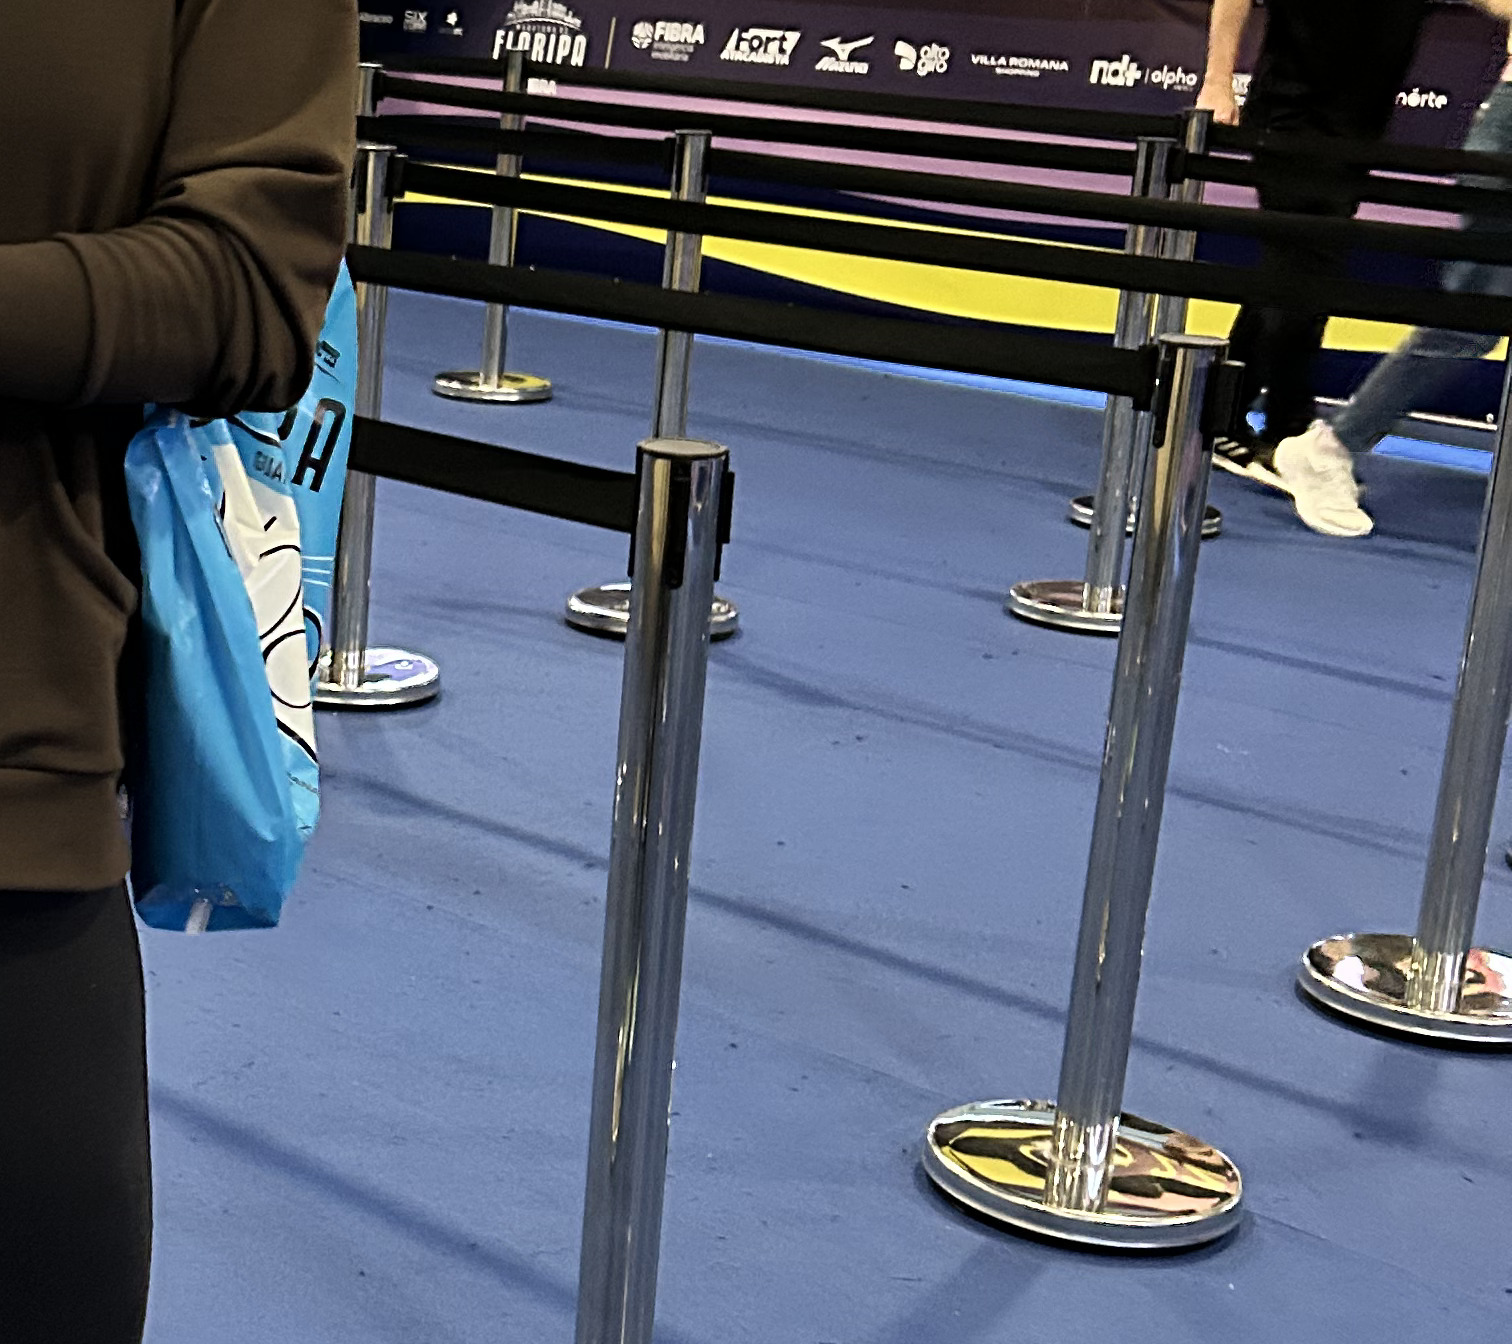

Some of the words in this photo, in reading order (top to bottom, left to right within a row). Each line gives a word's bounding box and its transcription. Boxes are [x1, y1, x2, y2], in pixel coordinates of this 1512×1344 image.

[654, 20, 705, 45] FIBRA
[971, 54, 1007, 67] VILLA
[1009, 57, 1069, 72] ROMANA
